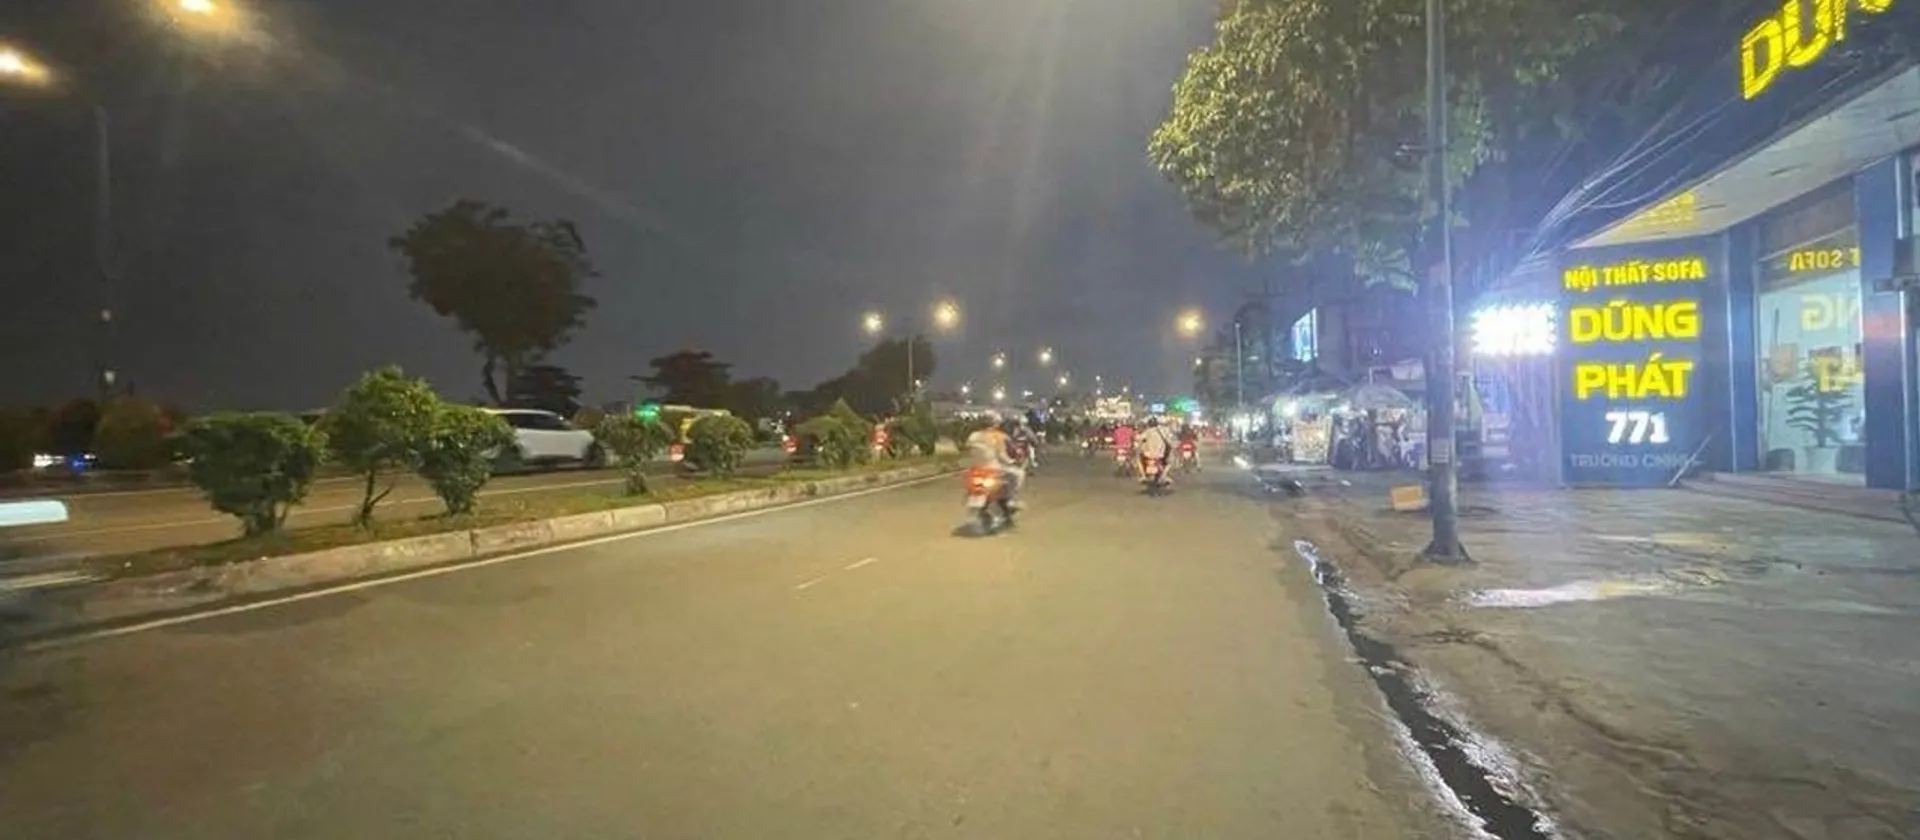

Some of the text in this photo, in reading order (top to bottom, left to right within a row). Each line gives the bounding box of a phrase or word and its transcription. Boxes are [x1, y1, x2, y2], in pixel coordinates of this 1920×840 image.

[1564, 258, 1704, 293] NỘI THẤT SOFA
[1570, 299, 1699, 343] DŨNG
[1575, 352, 1694, 400] PHÁT
[1605, 411, 1670, 445] 771
